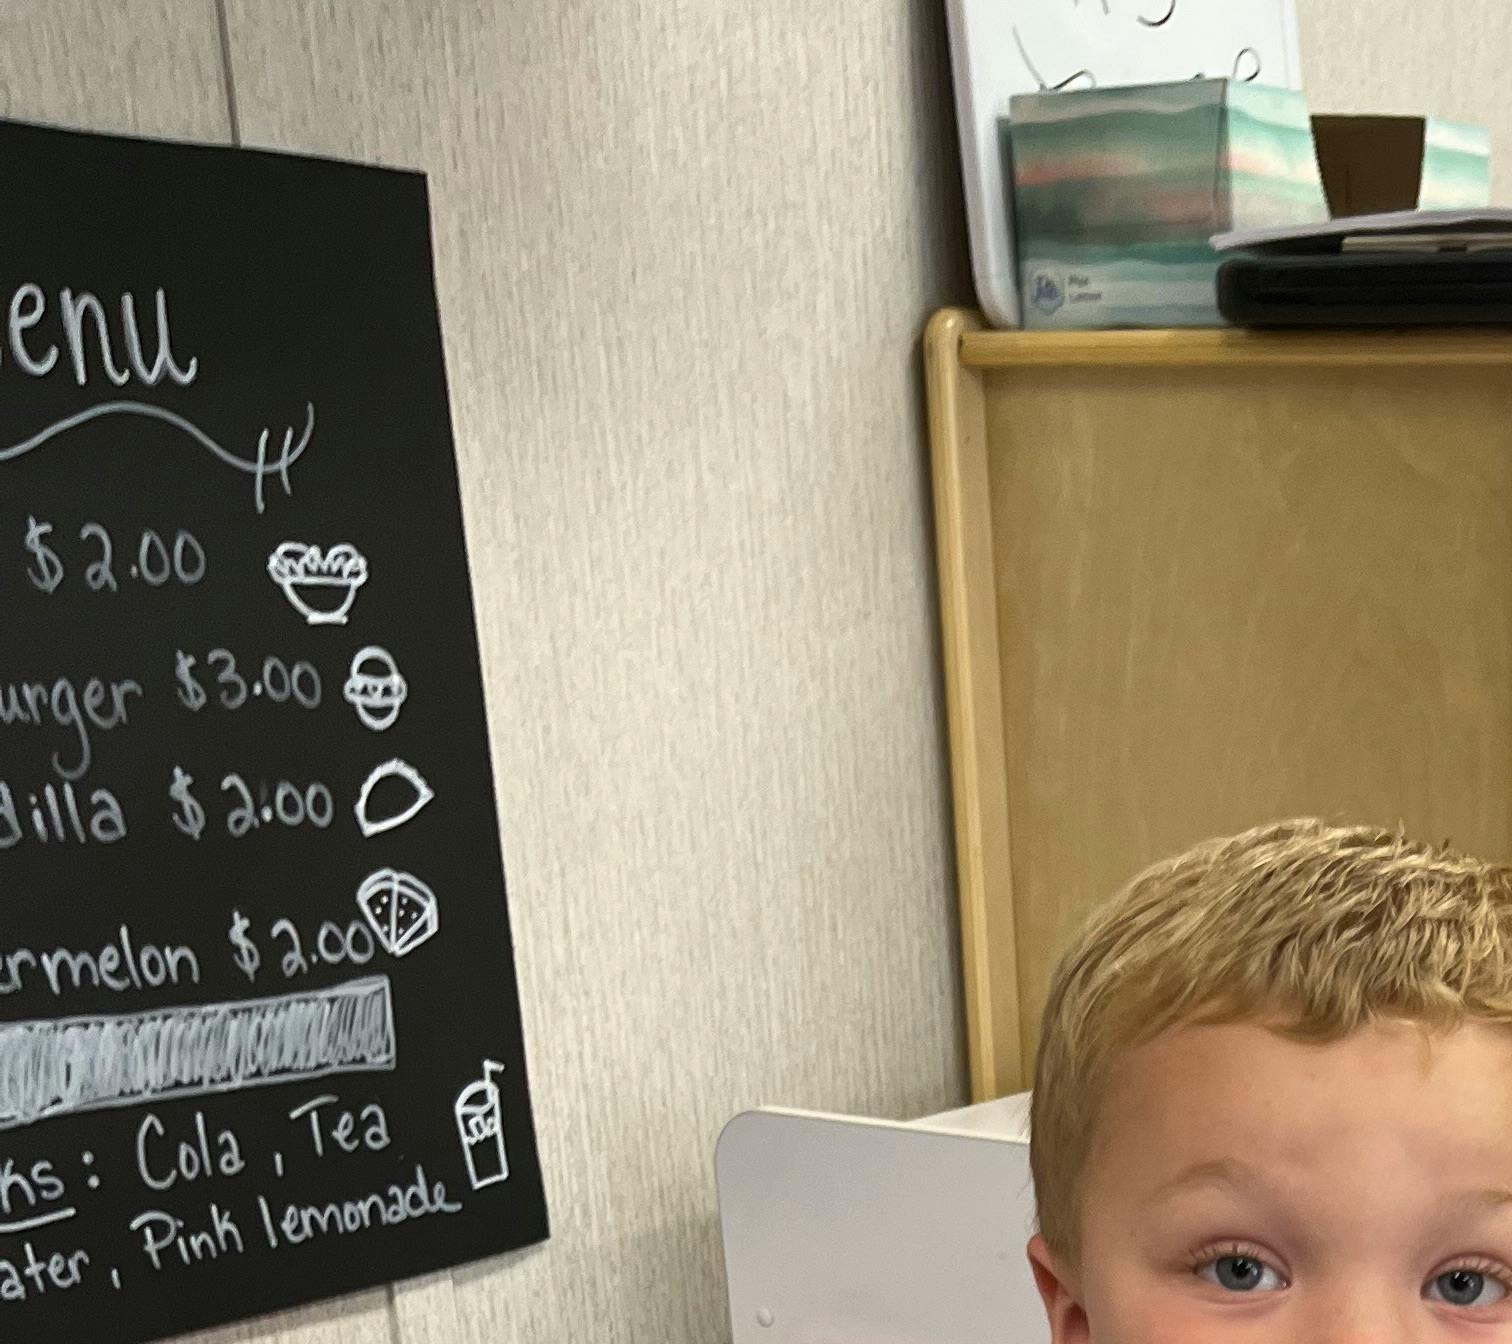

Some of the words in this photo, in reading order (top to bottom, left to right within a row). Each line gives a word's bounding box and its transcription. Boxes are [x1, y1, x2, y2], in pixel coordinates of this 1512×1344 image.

[0, 283, 198, 386] enu
[175, 648, 322, 711] $3.00
[170, 766, 334, 840] $2.00
[229, 910, 376, 982] $2.00
[288, 1095, 391, 1157] Tea
[129, 1203, 246, 1269] Pink
[257, 1164, 463, 1249] lemonade
